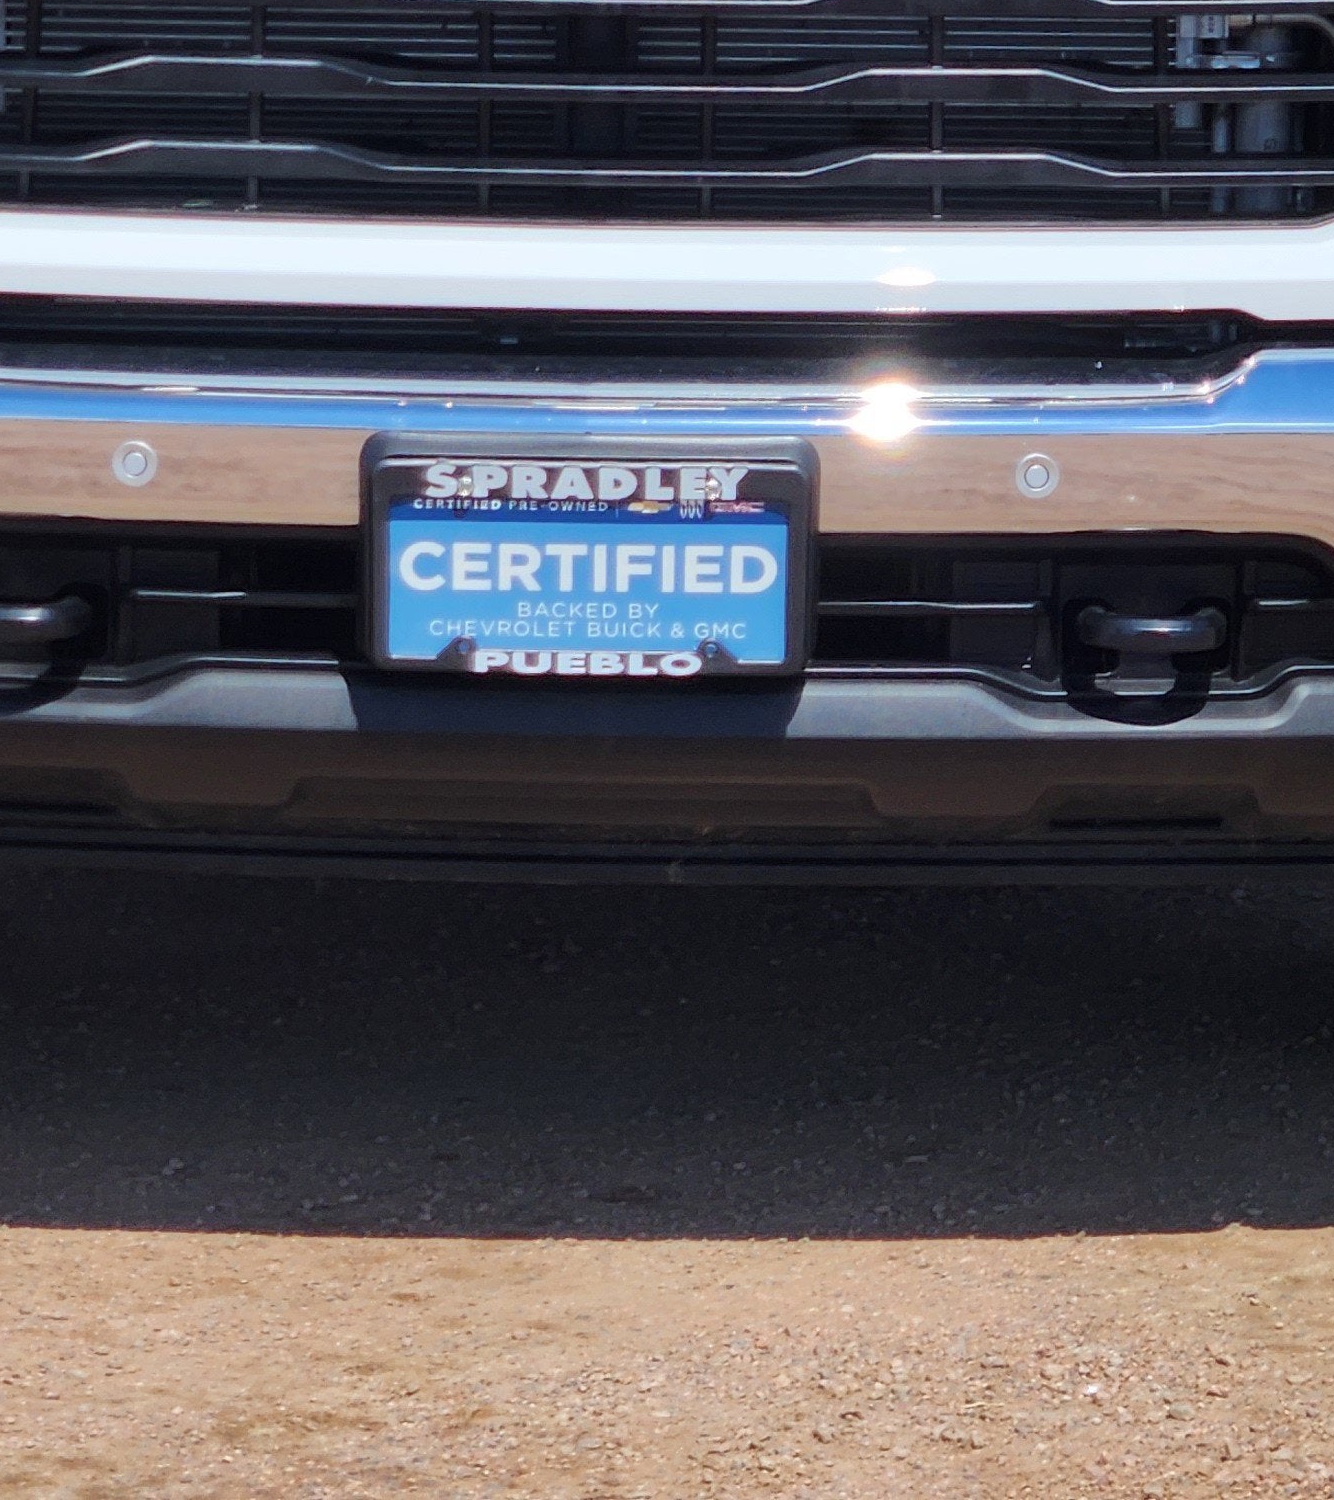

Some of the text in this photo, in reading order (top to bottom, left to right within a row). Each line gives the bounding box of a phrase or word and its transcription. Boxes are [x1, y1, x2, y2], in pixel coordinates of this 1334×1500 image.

[425, 464, 748, 500] SPRADLEY
[413, 499, 609, 512] CERTIFIED PRE-OWNED
[399, 541, 778, 594] CERTIFIED
[518, 602, 659, 619] BACKED BY
[429, 619, 746, 639] CHEVROLET BUICK & GMC
[473, 650, 703, 677] PUEBLO
